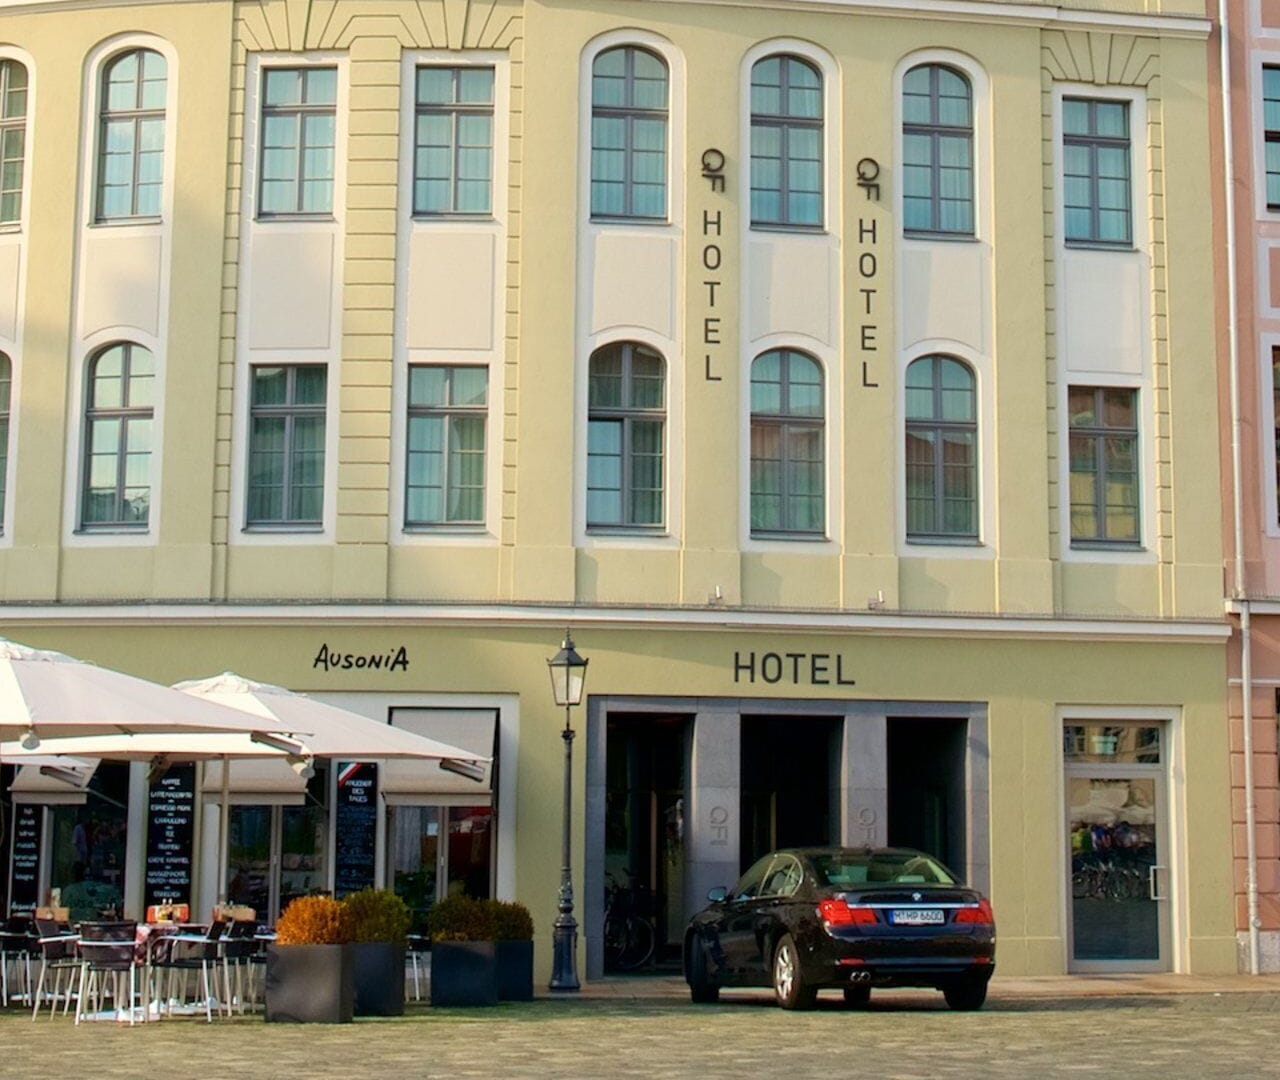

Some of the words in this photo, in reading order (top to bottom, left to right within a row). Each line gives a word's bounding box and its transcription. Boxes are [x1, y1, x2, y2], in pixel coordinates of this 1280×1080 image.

[701, 148, 725, 193] QF
[856, 157, 880, 201] QF
[703, 209, 722, 381] HOTEL
[858, 218, 878, 388] HOTEL
[734, 651, 855, 685] HOTEL
